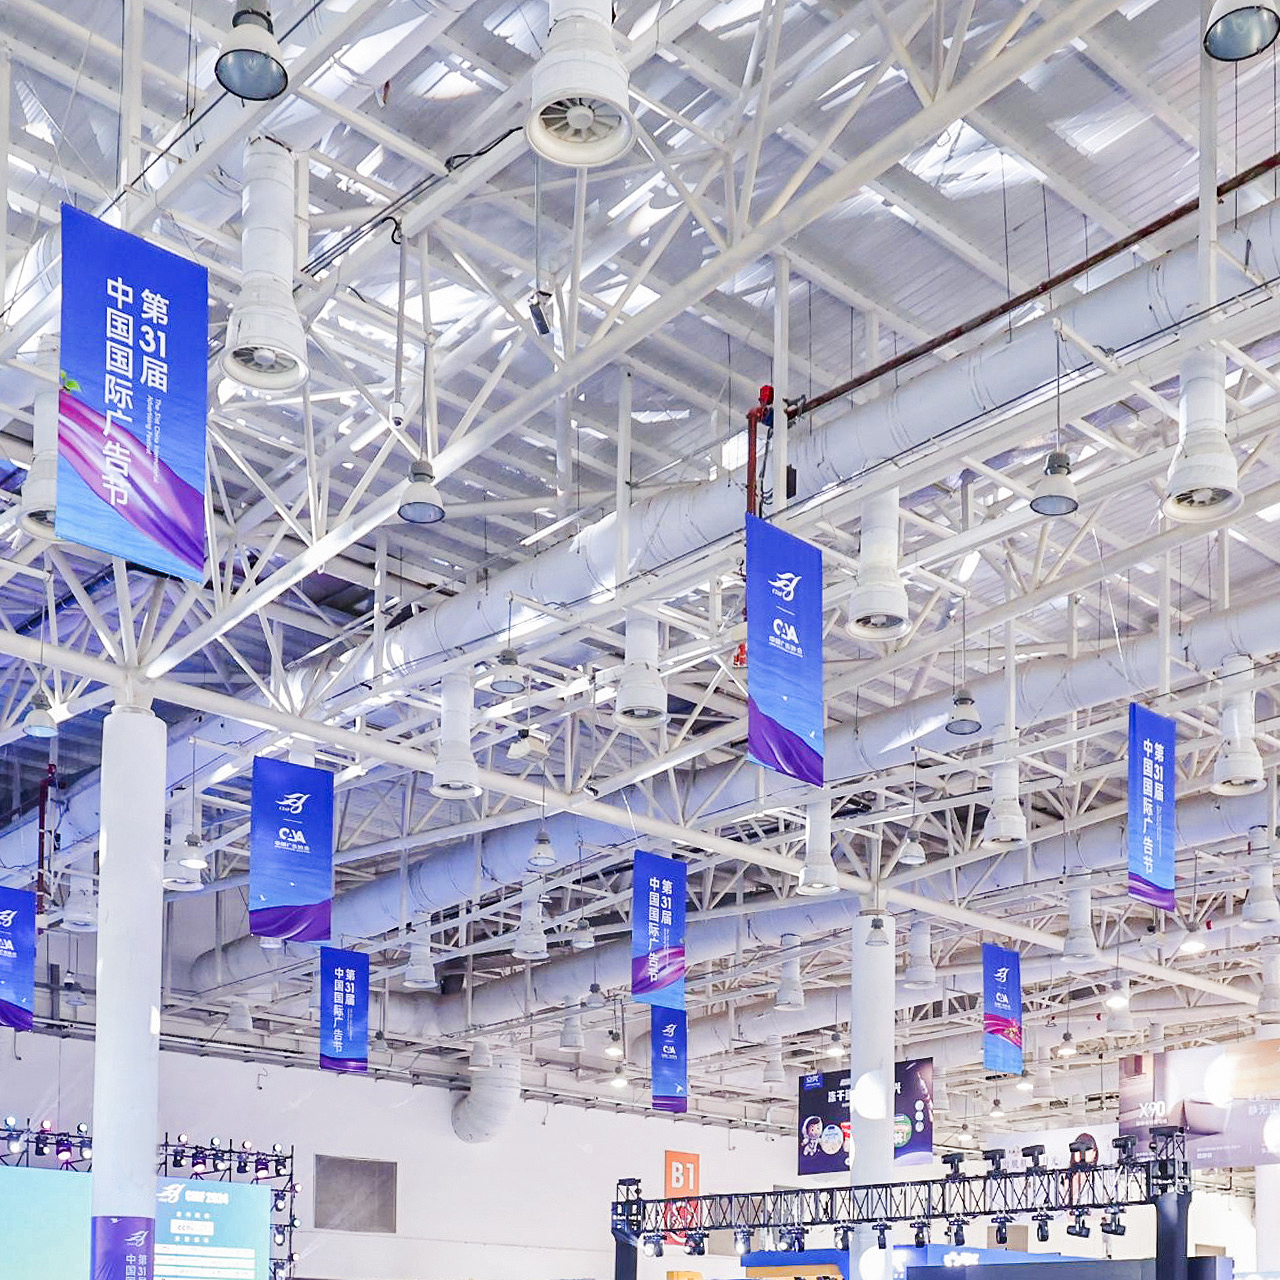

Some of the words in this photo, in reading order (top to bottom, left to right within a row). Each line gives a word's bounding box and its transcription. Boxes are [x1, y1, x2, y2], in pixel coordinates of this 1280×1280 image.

[102, 276, 134, 506] 中国国际广告节
[138, 288, 170, 394] 第31届
[1142, 738, 1154, 874] 中国国际广告节
[648, 877, 660, 983] 中国国际广告节
[333, 967, 344, 1053] 中国国际广告节
[1138, 1101, 1165, 1118] X90
[671, 1161, 695, 1191] B1
